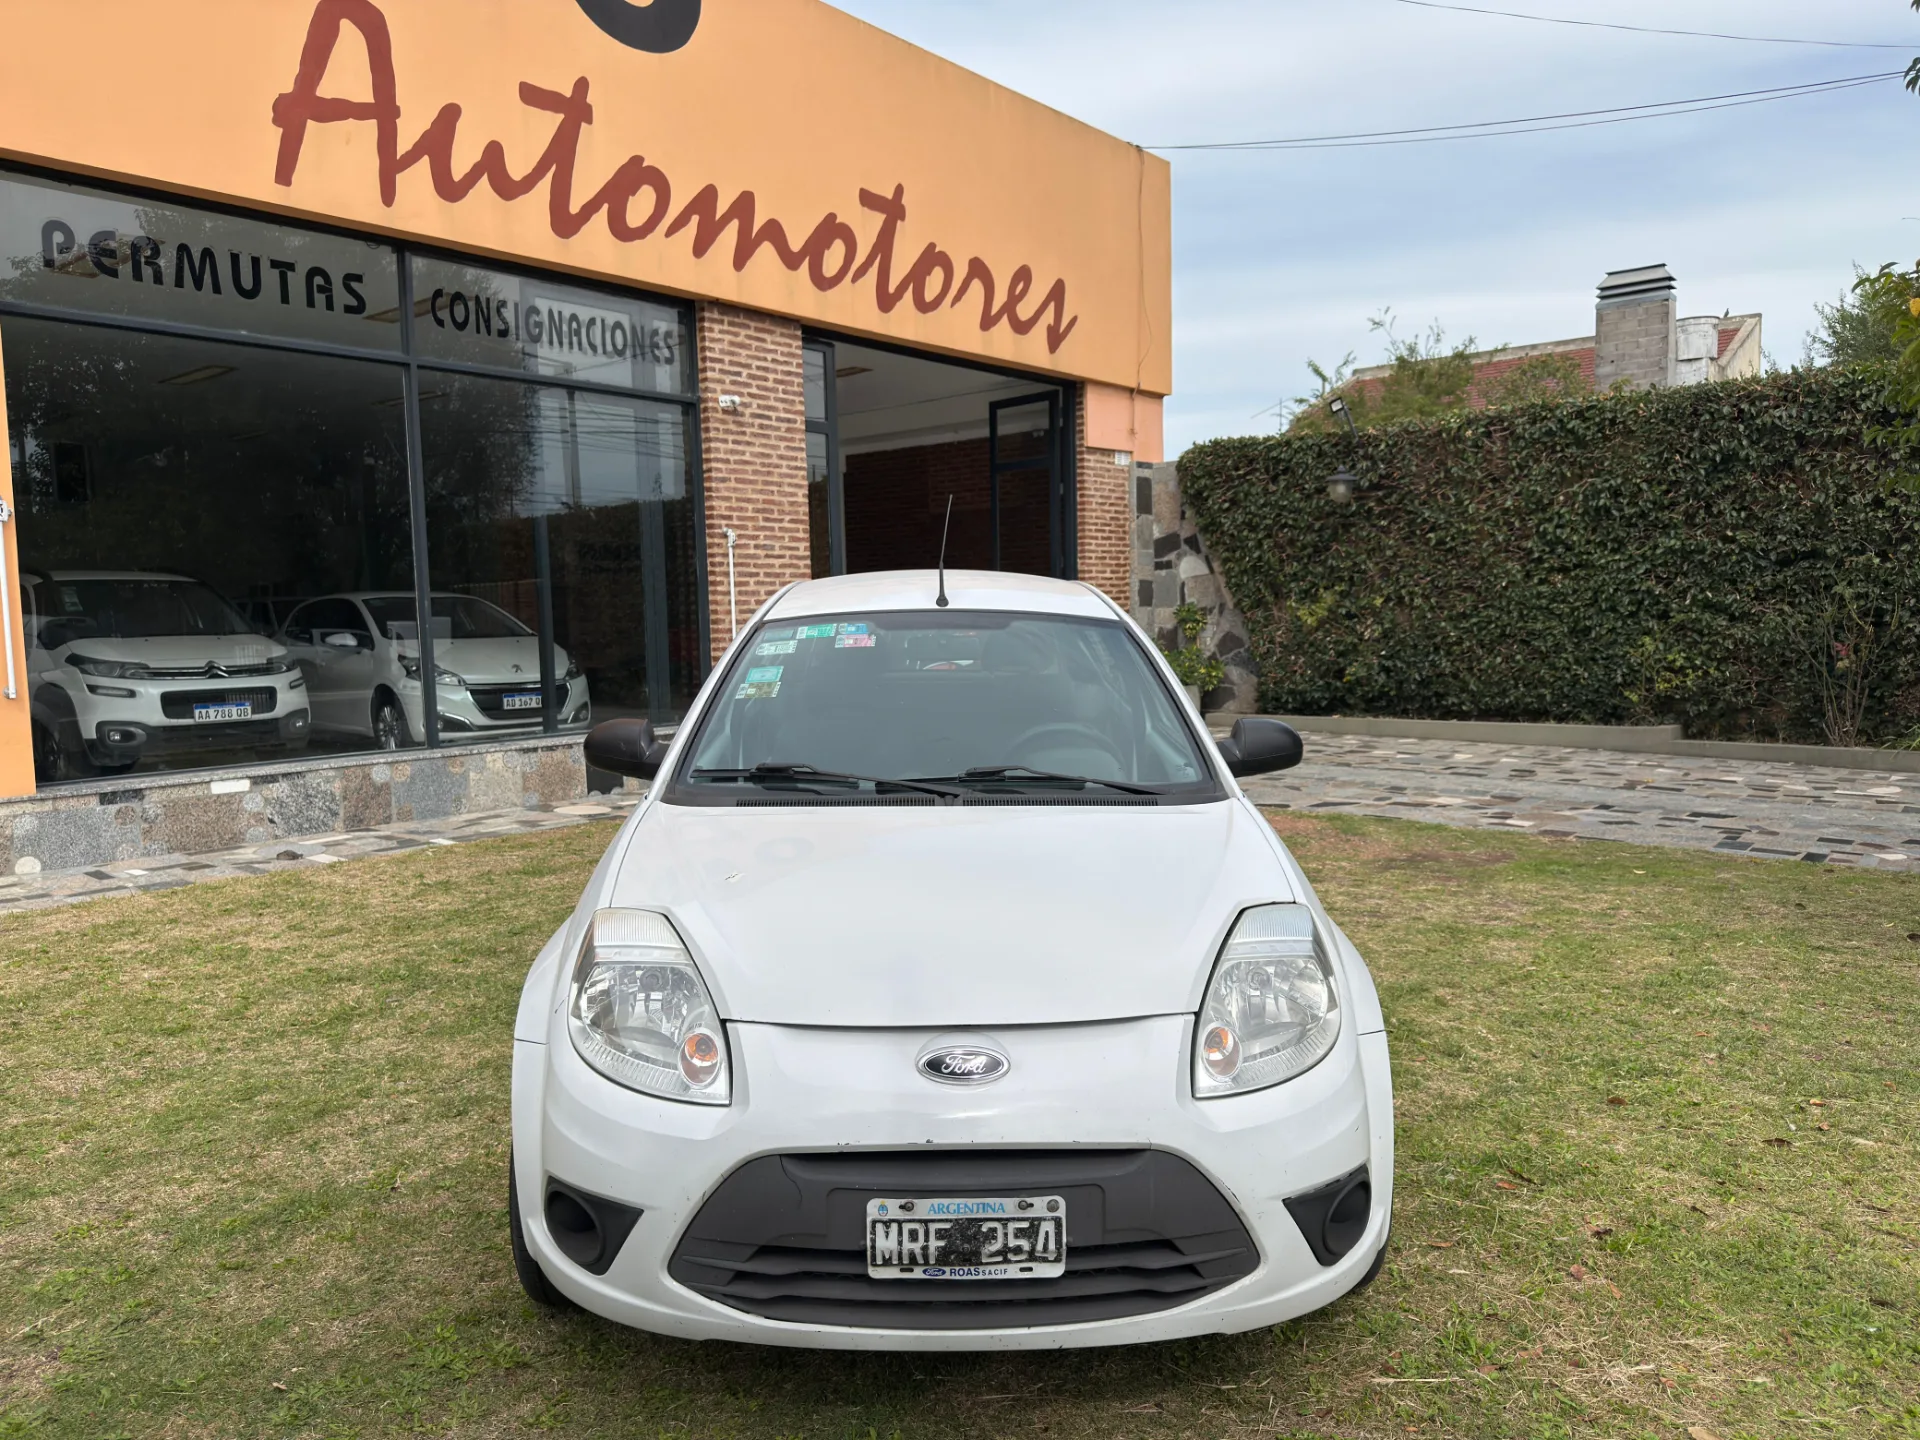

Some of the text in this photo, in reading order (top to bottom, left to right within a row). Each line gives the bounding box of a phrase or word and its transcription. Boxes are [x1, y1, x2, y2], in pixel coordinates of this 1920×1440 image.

[272, 0, 1078, 355] Automotores
[41, 218, 367, 316] PERMUTAS
[430, 287, 675, 367] CONSIGNACIONES
[198, 710, 211, 720] AA
[213, 709, 233, 719] 788
[941, 1054, 987, 1073] Ford
[927, 1202, 1006, 1215] ARGENTINA
[875, 1221, 954, 1265] MRF
[925, 1268, 945, 1276] Ford
[949, 1267, 980, 1277] ROAS
